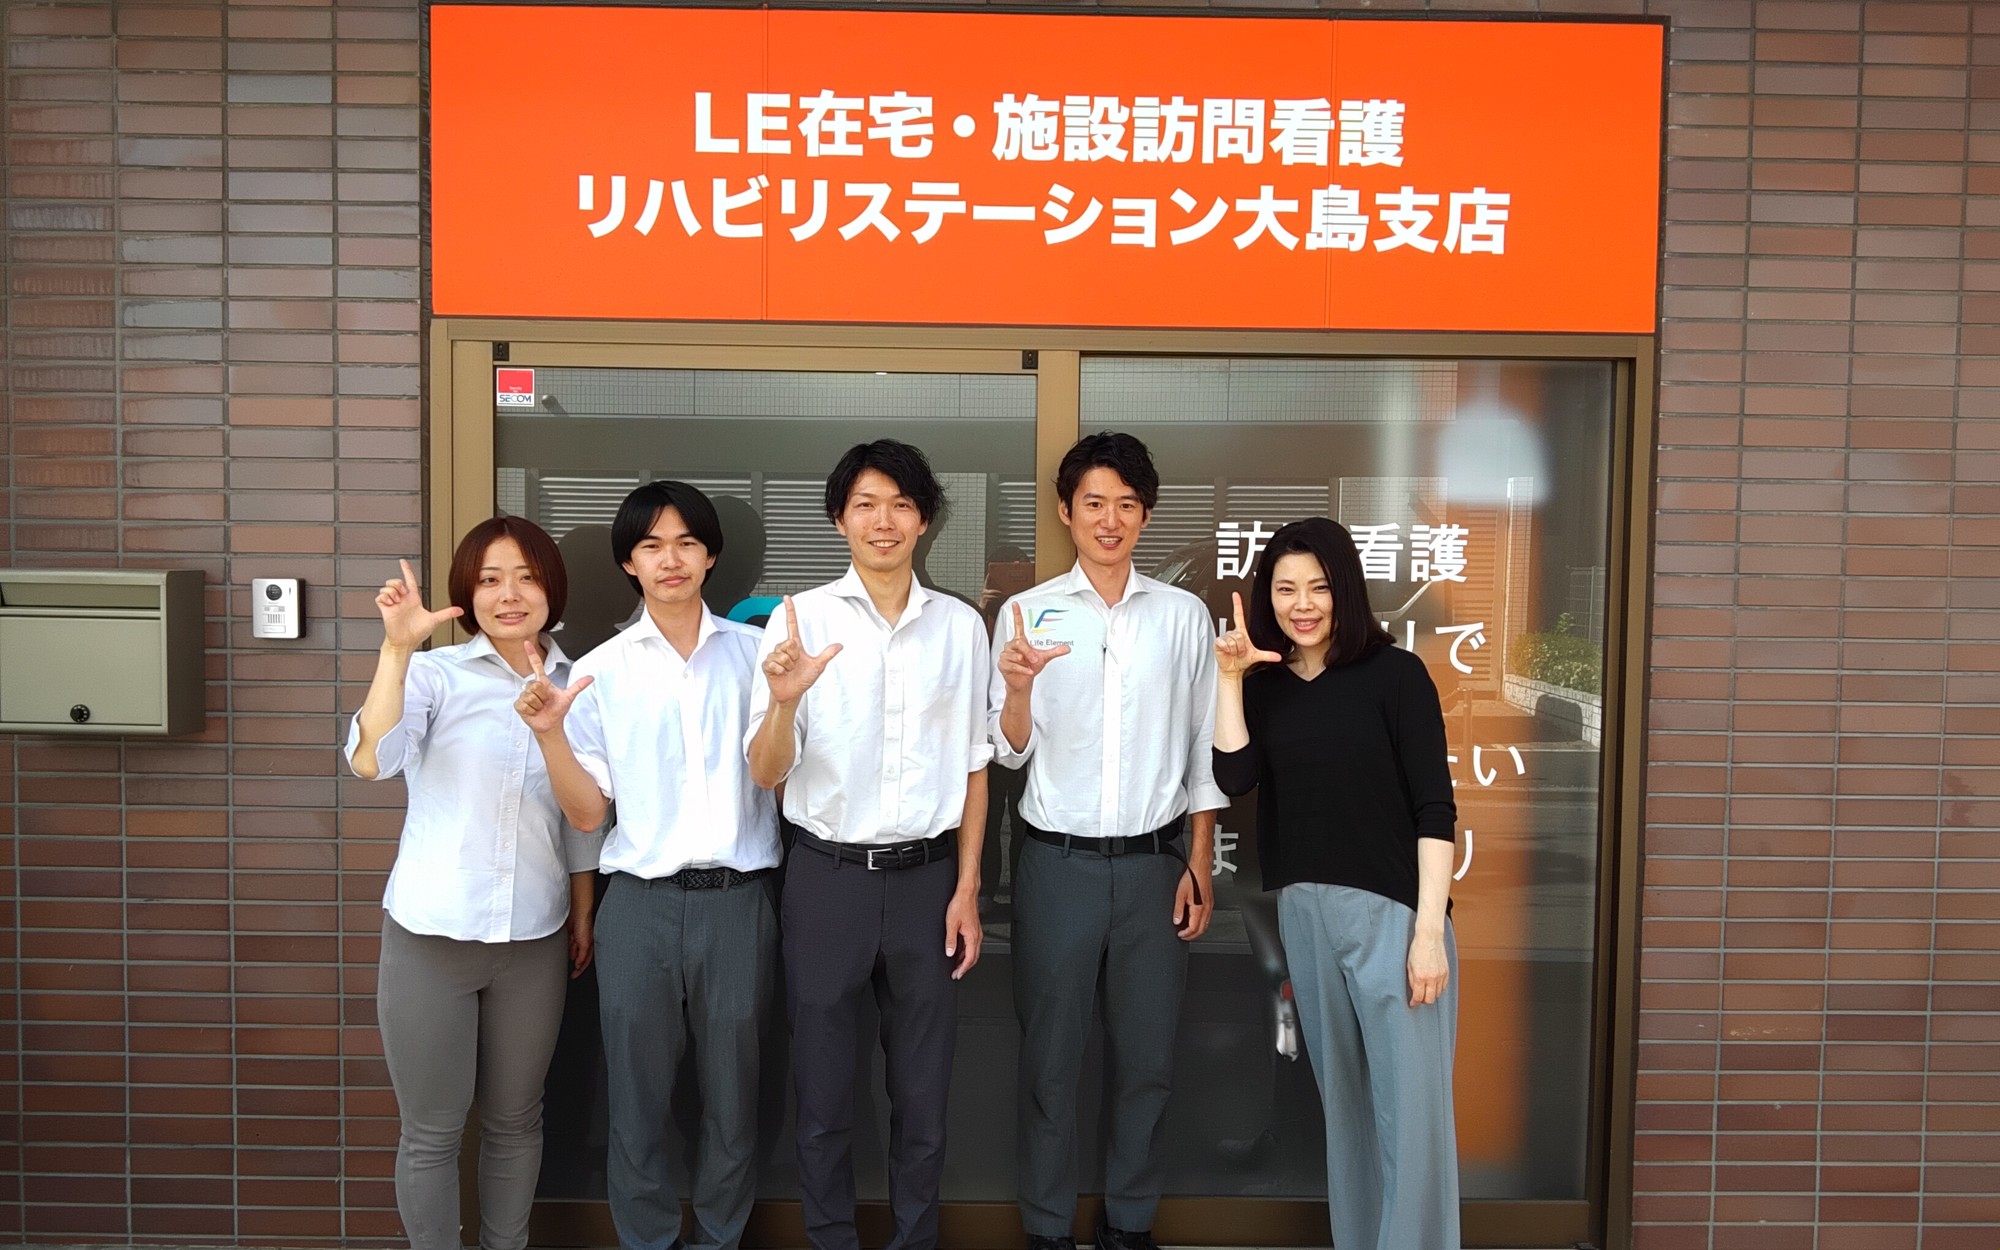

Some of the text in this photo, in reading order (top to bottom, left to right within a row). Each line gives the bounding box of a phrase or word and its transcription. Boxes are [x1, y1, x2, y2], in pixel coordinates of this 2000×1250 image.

[693, 89, 1406, 168] LE在宅・施設訪問看護
[577, 174, 1511, 256] リハビリステーション大島支店
[499, 394, 532, 403] SECOM
[1215, 520, 1469, 583] 訪看護
